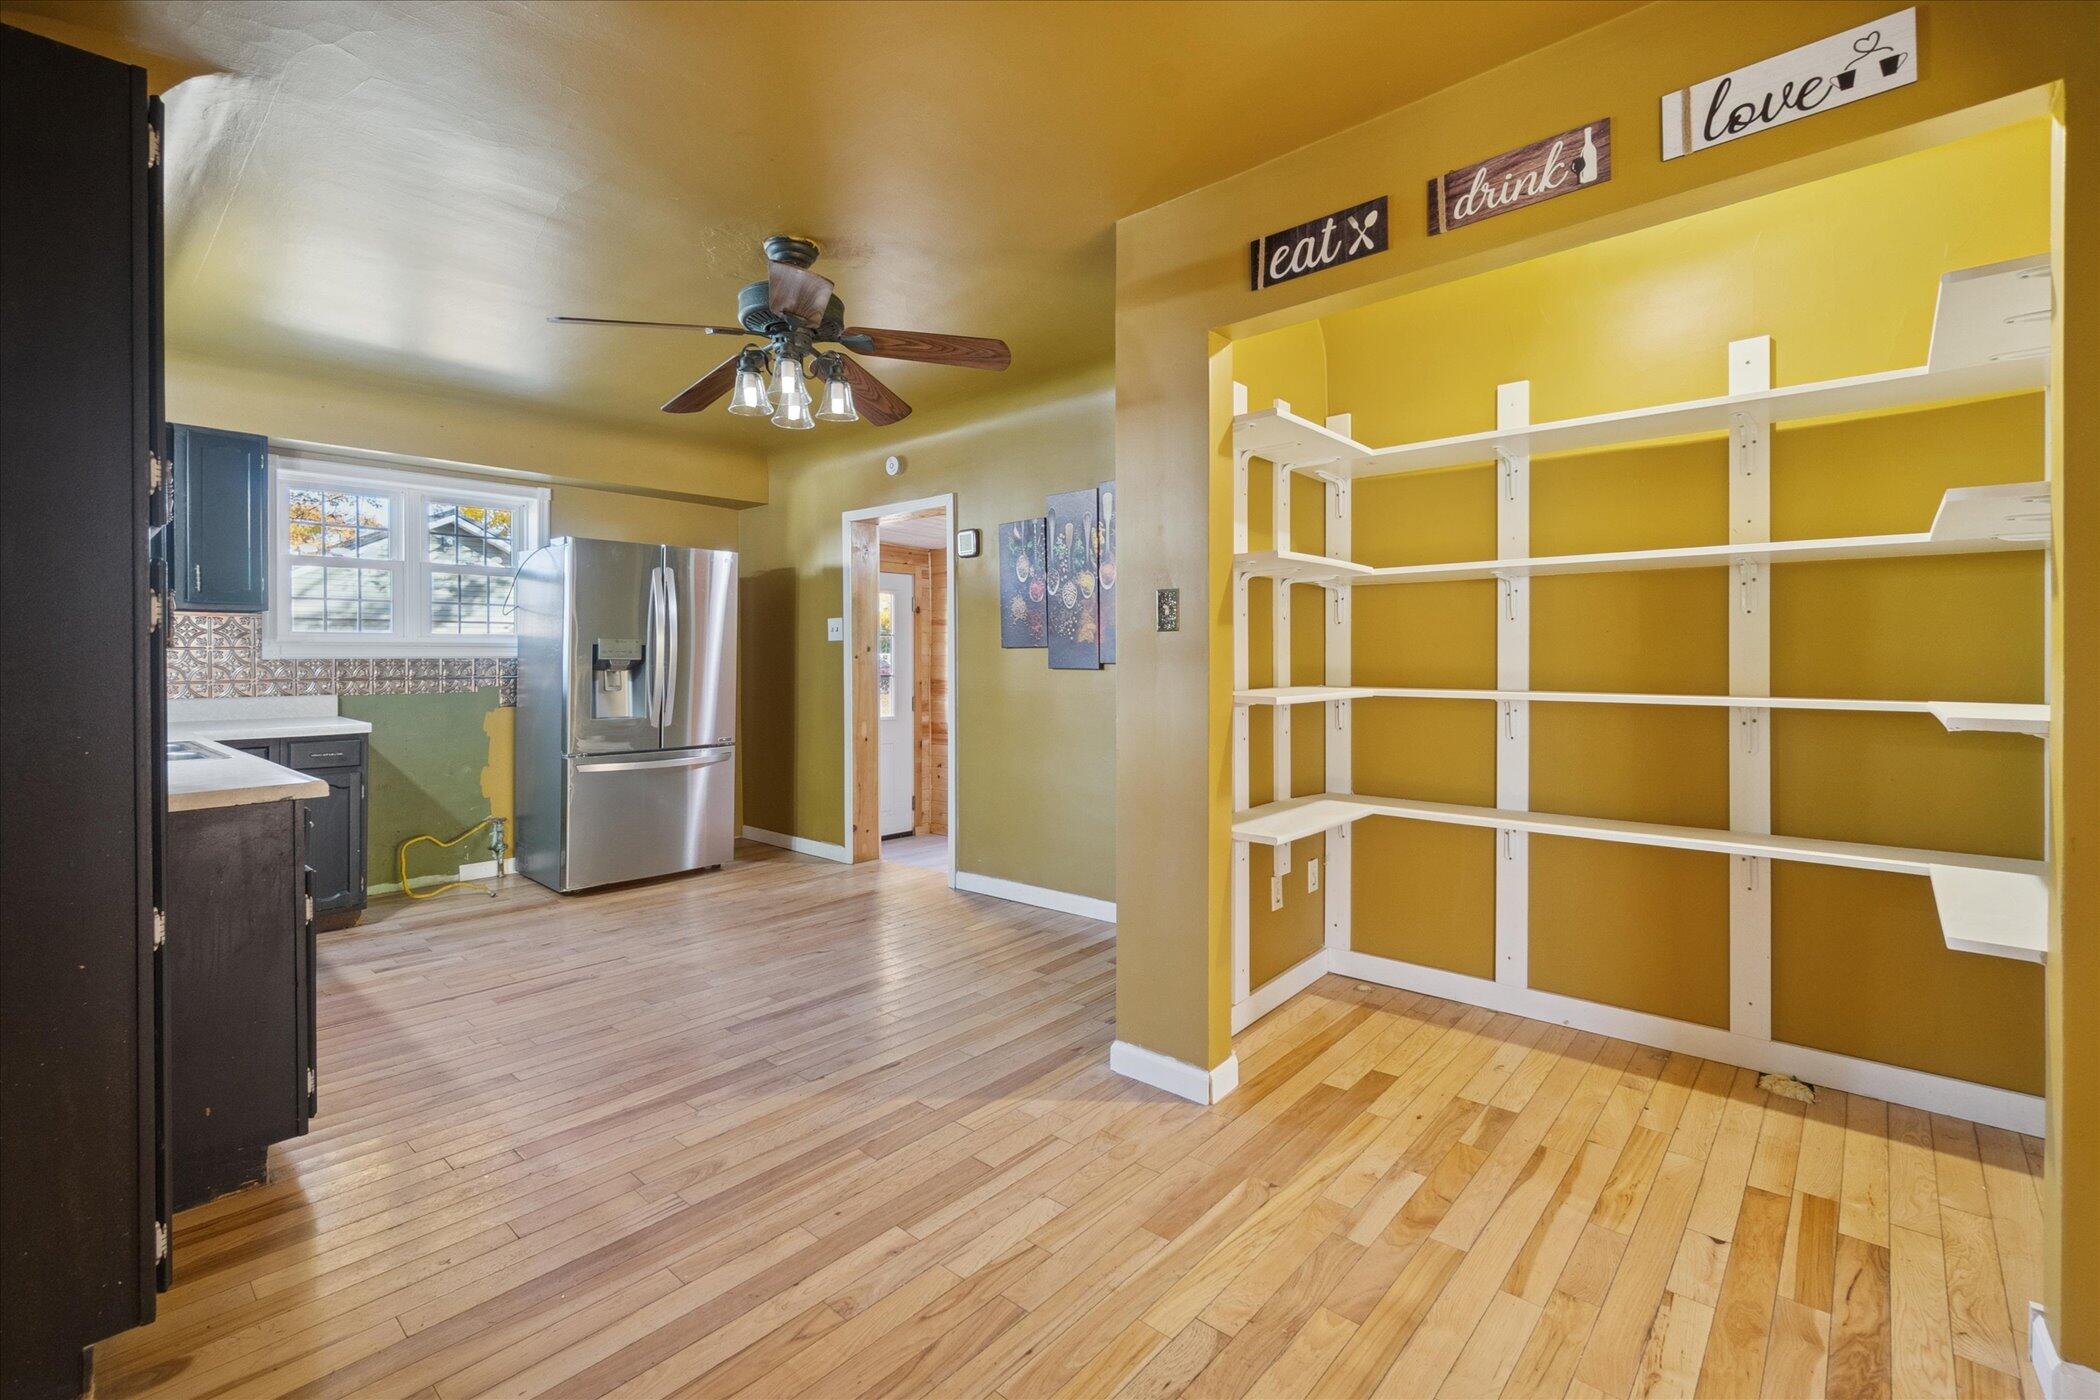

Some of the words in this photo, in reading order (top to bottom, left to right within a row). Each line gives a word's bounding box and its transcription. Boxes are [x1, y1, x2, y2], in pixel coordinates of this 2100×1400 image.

[1703, 77, 1833, 142] love
[1453, 140, 1569, 220] drink
[1269, 217, 1342, 279] eat
